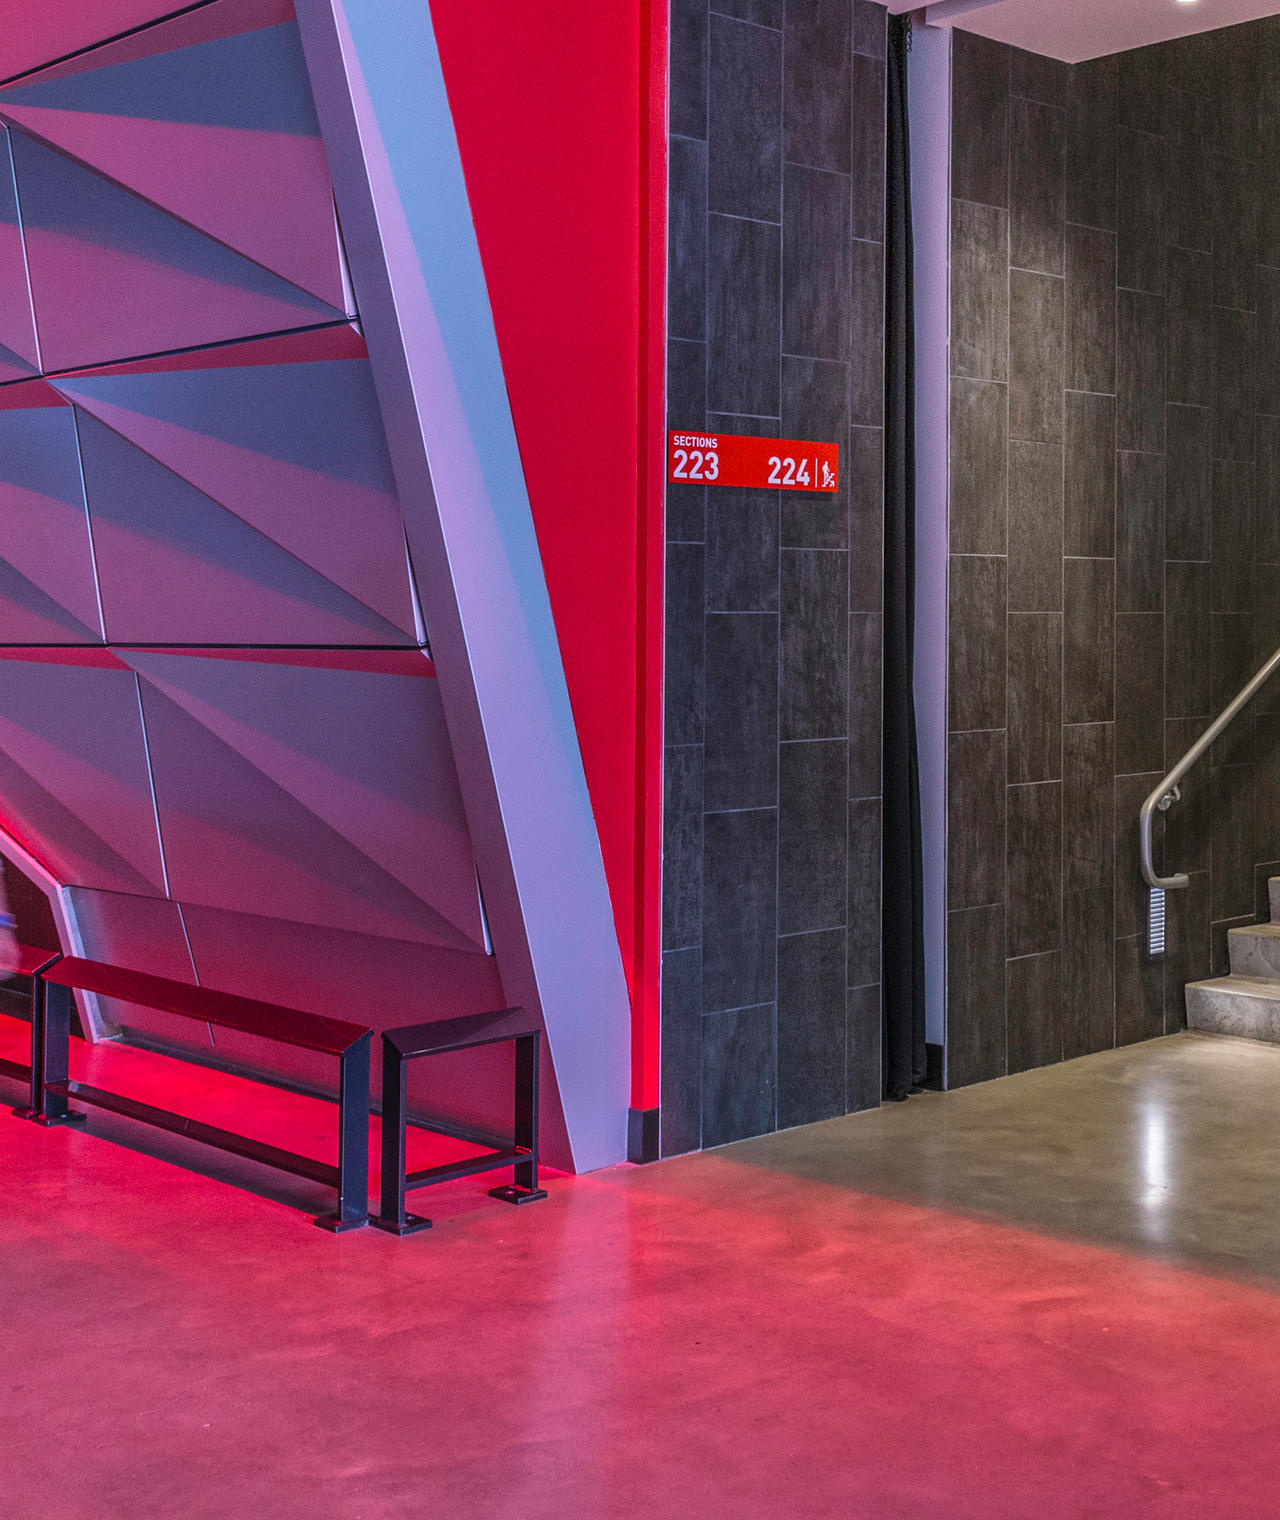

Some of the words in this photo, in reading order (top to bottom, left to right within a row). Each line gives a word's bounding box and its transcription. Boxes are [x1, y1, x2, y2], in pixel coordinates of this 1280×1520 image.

[673, 435, 718, 449] SECTIONS
[673, 449, 719, 481] 223
[767, 456, 811, 486] 224
